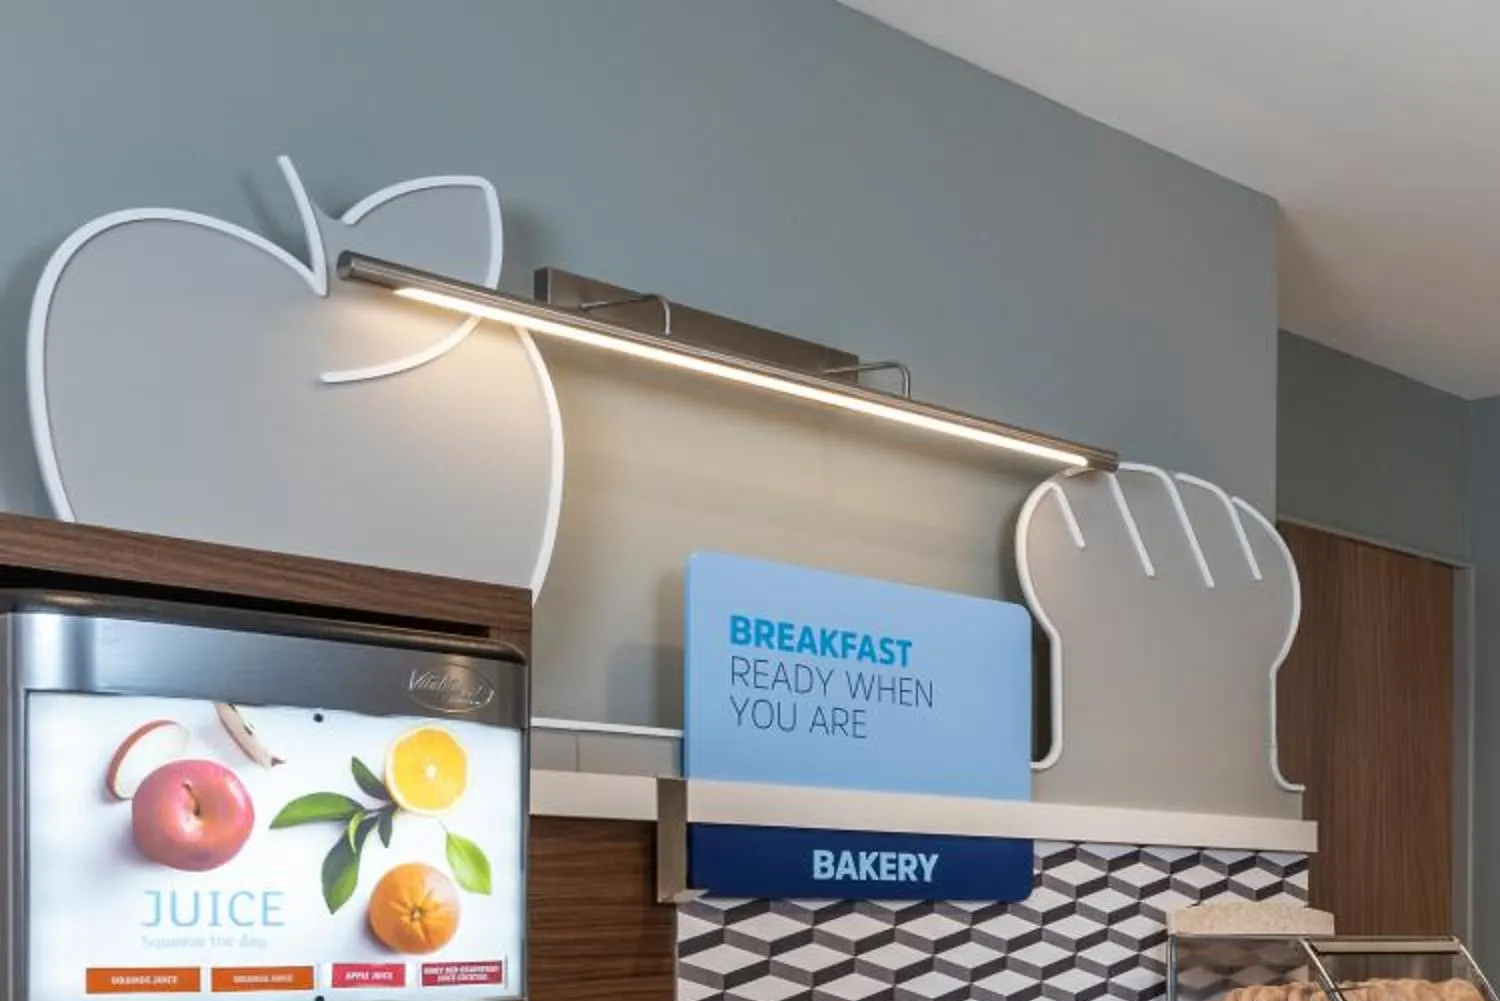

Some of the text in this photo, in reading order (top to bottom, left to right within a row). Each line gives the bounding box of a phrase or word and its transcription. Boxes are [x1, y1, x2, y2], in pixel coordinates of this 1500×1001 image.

[730, 615, 912, 667] BREAKFAST
[730, 655, 933, 708] READY WHEN
[730, 696, 867, 738] YOU ARE
[813, 850, 938, 883] BAKERY
[141, 890, 285, 927] JUICE
